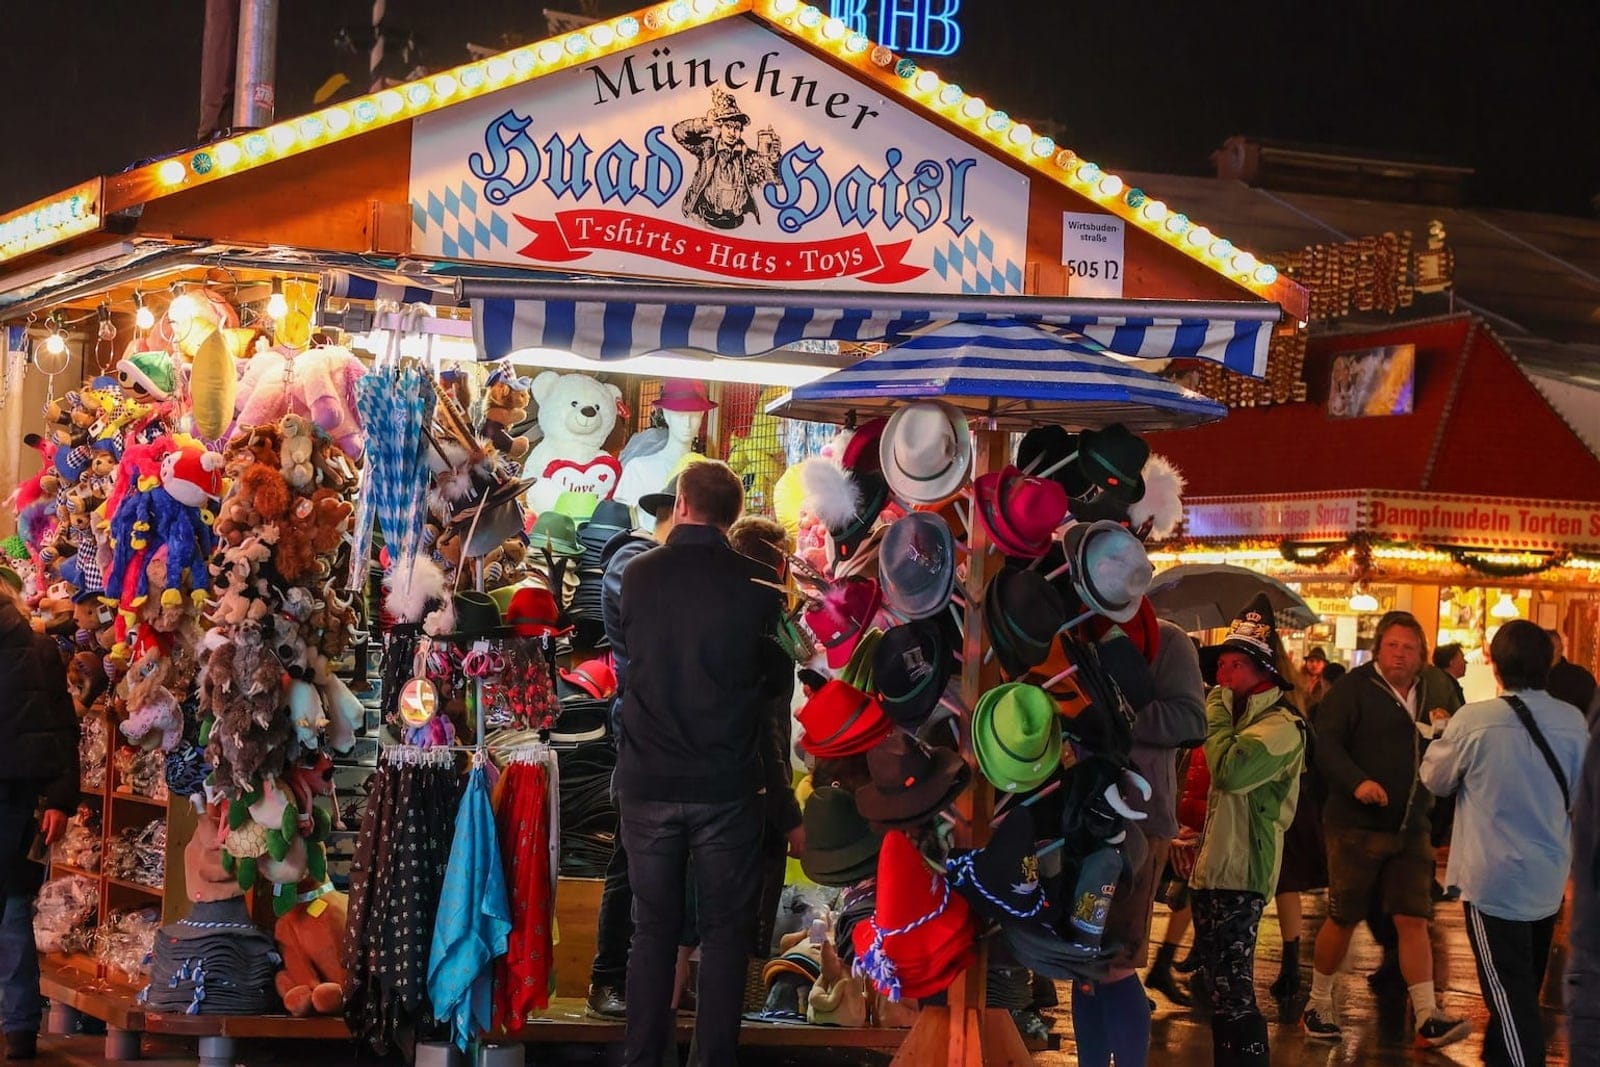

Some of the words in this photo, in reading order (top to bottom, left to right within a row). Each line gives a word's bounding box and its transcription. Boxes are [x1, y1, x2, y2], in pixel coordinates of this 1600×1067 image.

[586, 46, 879, 131] Münchner
[1068, 220, 1120, 233] Wirtsbuden-
[575, 216, 685, 255] T-shirts
[706, 243, 777, 273] Hats
[800, 246, 864, 278] Toys
[1080, 233, 1107, 243] straße
[1068, 260, 1098, 278] 505
[569, 482, 595, 493] love
[1372, 500, 1511, 533] Dampfnudeln
[1518, 509, 1582, 535] Torten
